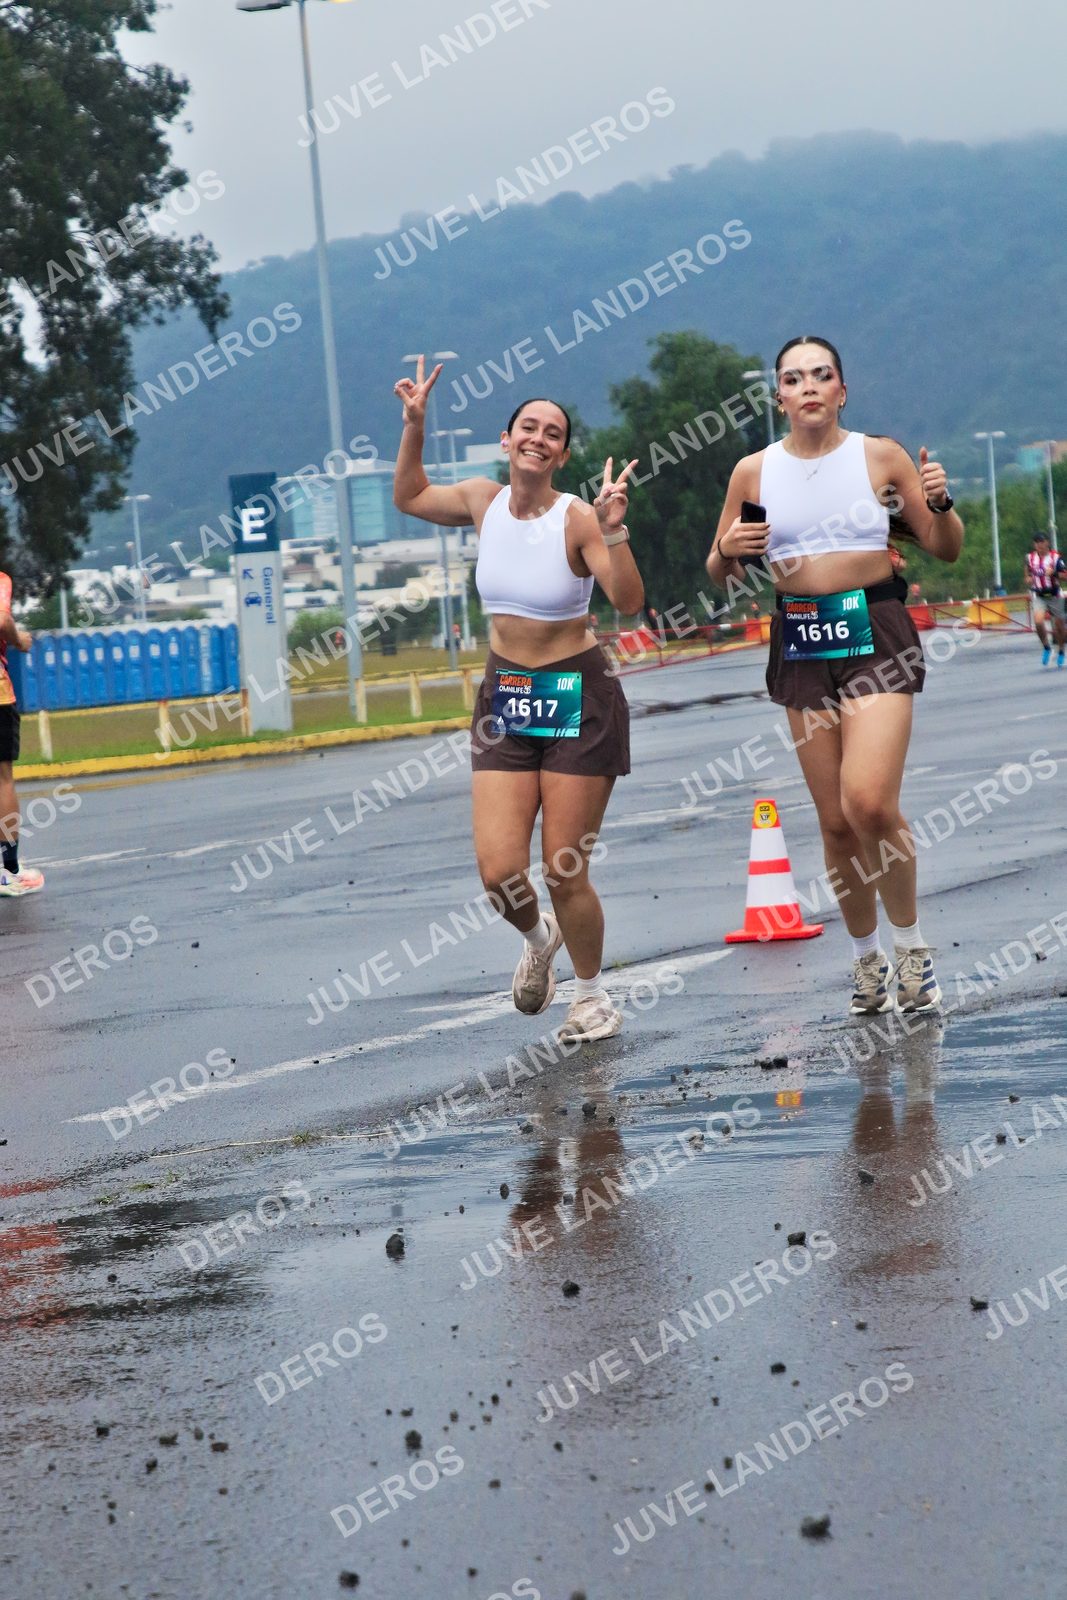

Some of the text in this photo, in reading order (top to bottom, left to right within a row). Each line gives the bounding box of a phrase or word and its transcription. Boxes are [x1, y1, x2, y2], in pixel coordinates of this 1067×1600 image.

[242, 507, 267, 542] E
[842, 596, 859, 611] 10K
[797, 620, 850, 642] 1616
[500, 675, 532, 687] CARRERA
[557, 677, 575, 691] 10K
[507, 698, 558, 718] 1617
